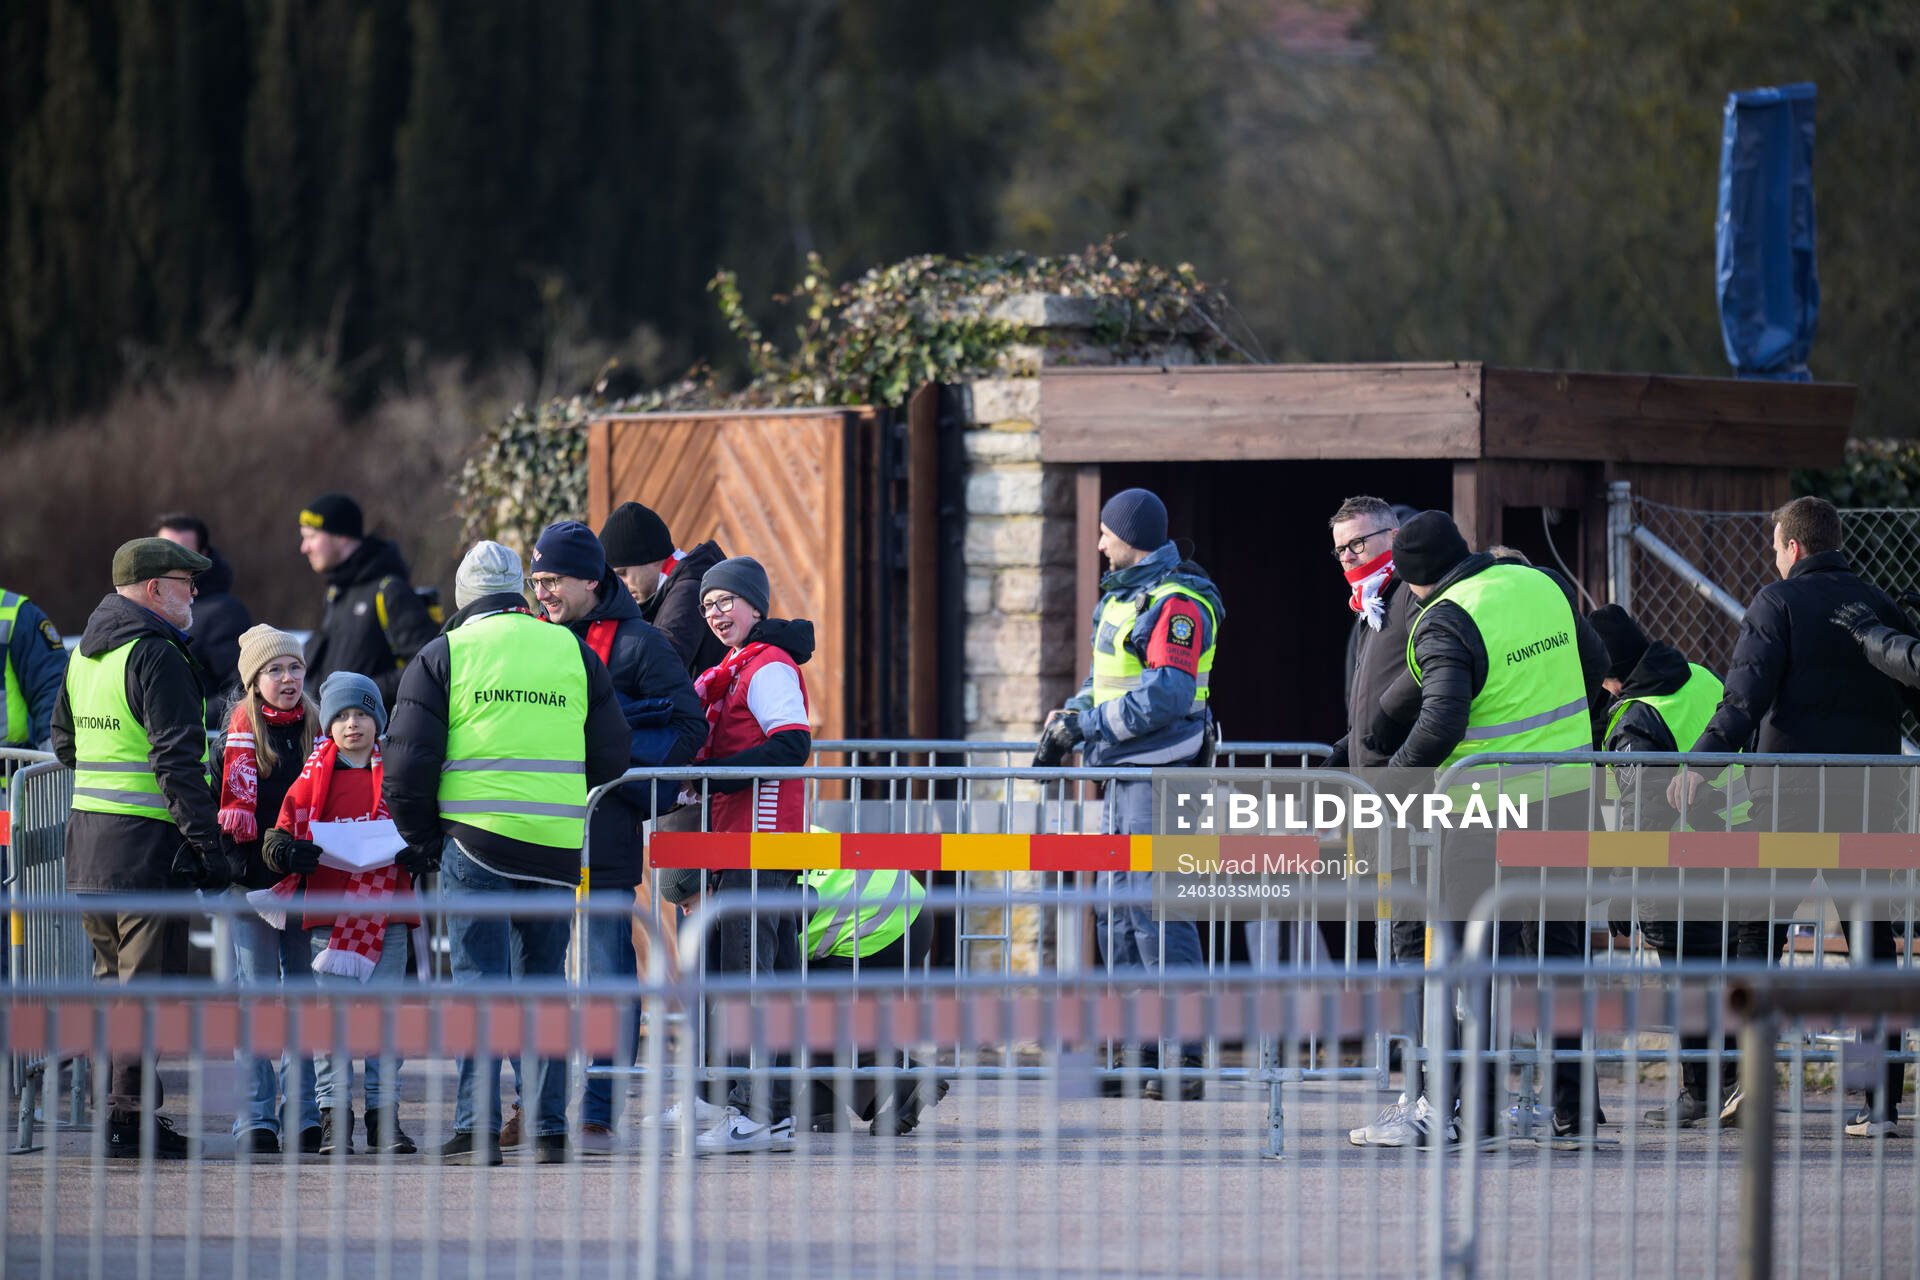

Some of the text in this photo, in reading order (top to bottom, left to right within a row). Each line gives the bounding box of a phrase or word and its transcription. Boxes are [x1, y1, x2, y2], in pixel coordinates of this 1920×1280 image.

[1506, 631, 1570, 666] FUNKTIONÄR
[474, 688, 567, 708] FUNKTIONÄR
[73, 715, 121, 731] NKTIONÄR
